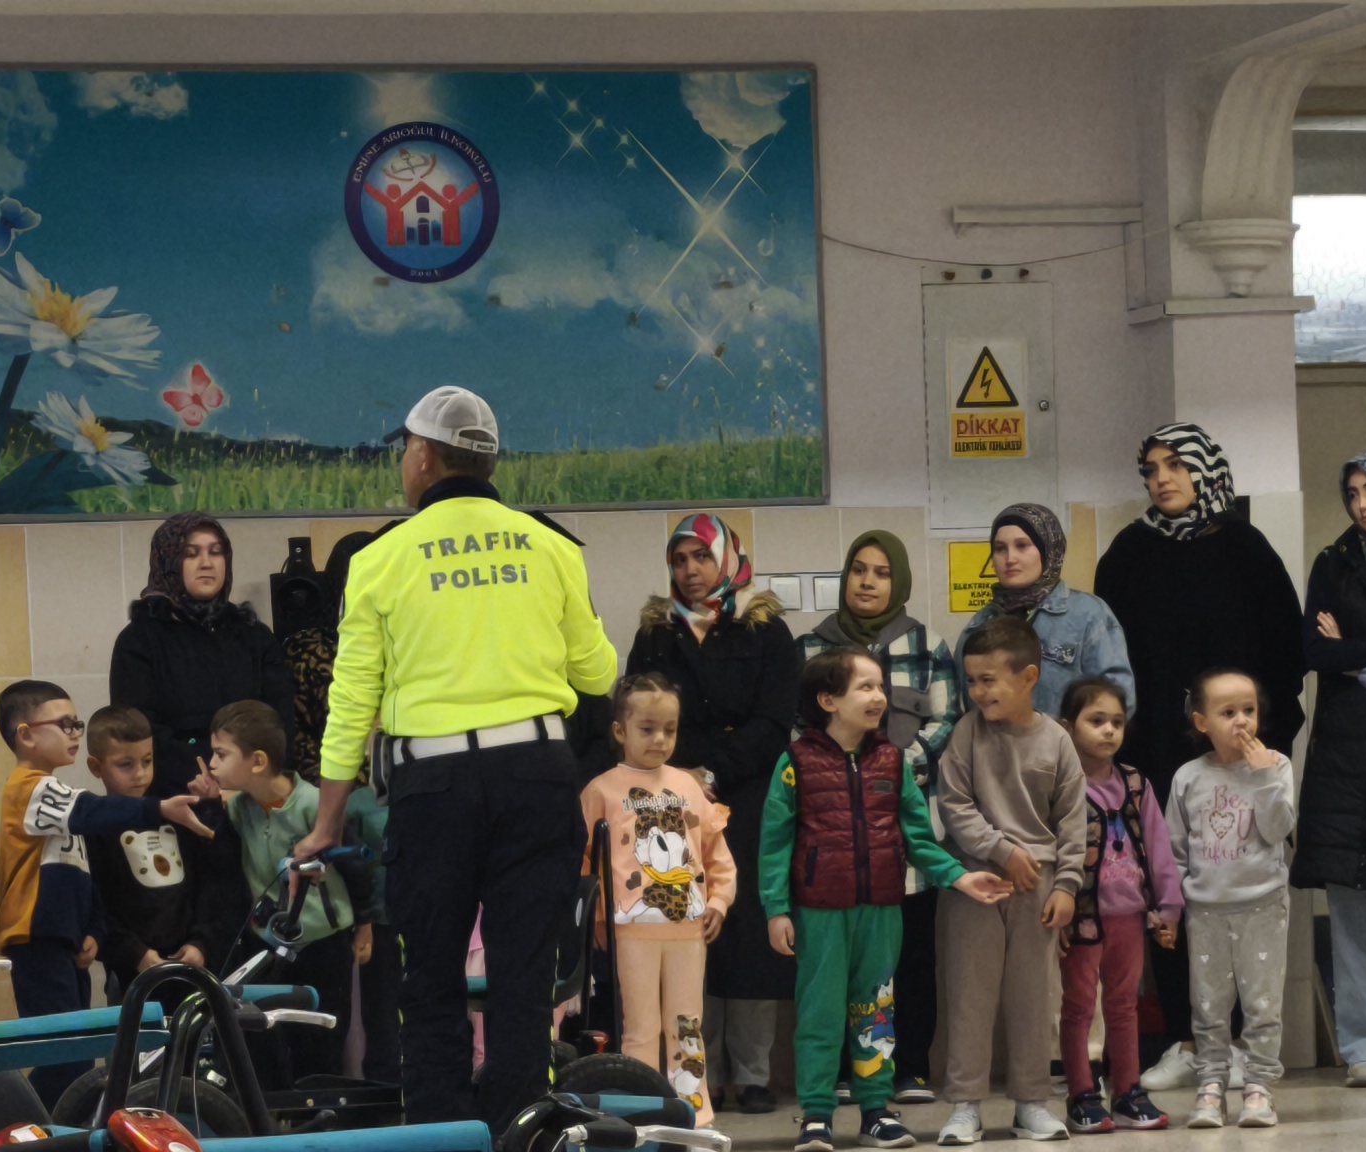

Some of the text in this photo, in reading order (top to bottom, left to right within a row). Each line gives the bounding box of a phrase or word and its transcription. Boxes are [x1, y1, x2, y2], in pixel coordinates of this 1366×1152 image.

[956, 414, 1021, 434] DİKKAT
[418, 531, 534, 560] TRAFİK
[430, 563, 529, 592] POLİSİ
